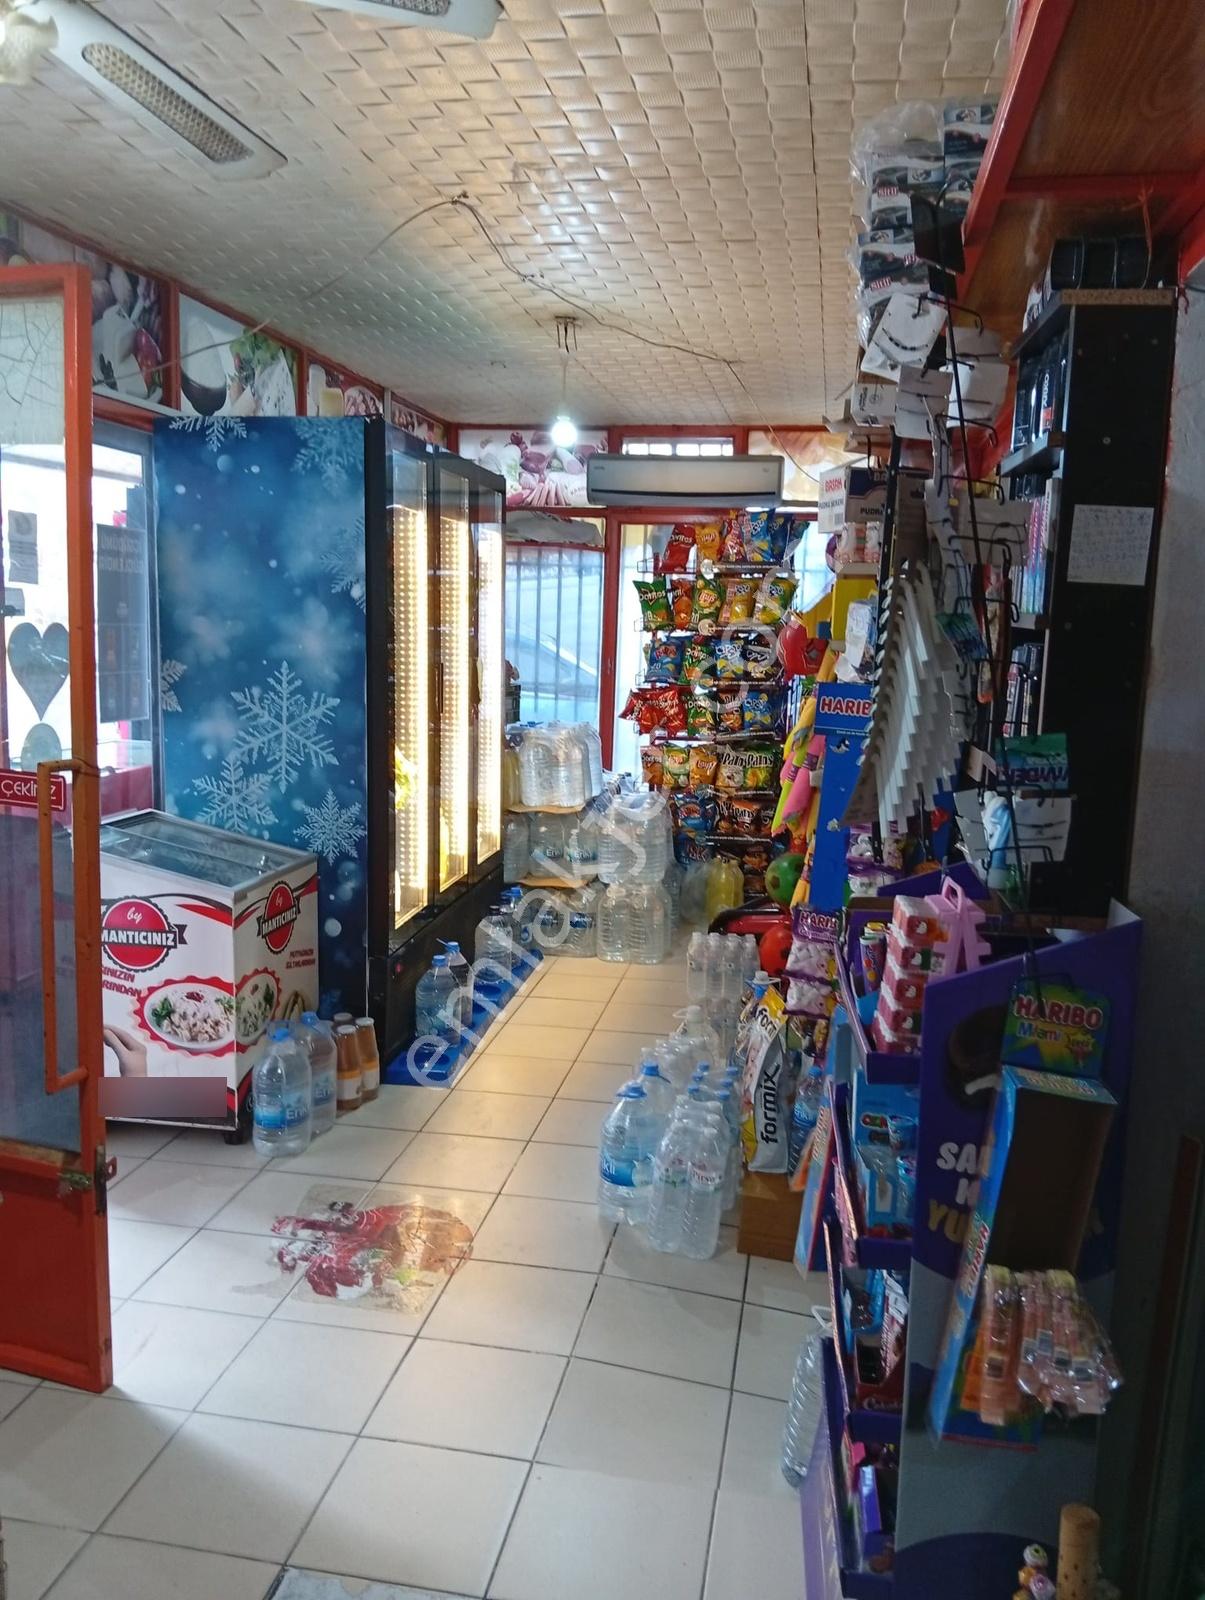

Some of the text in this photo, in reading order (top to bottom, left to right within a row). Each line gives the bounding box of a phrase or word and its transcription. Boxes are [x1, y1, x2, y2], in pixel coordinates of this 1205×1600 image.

[820, 696, 873, 717] HARIB
[1, 779, 56, 797] ÇEKİZ
[126, 907, 142, 924] by
[799, 911, 838, 929] HARIB
[1013, 993, 1104, 1030] HARIBO
[761, 1063, 781, 1145] formix
